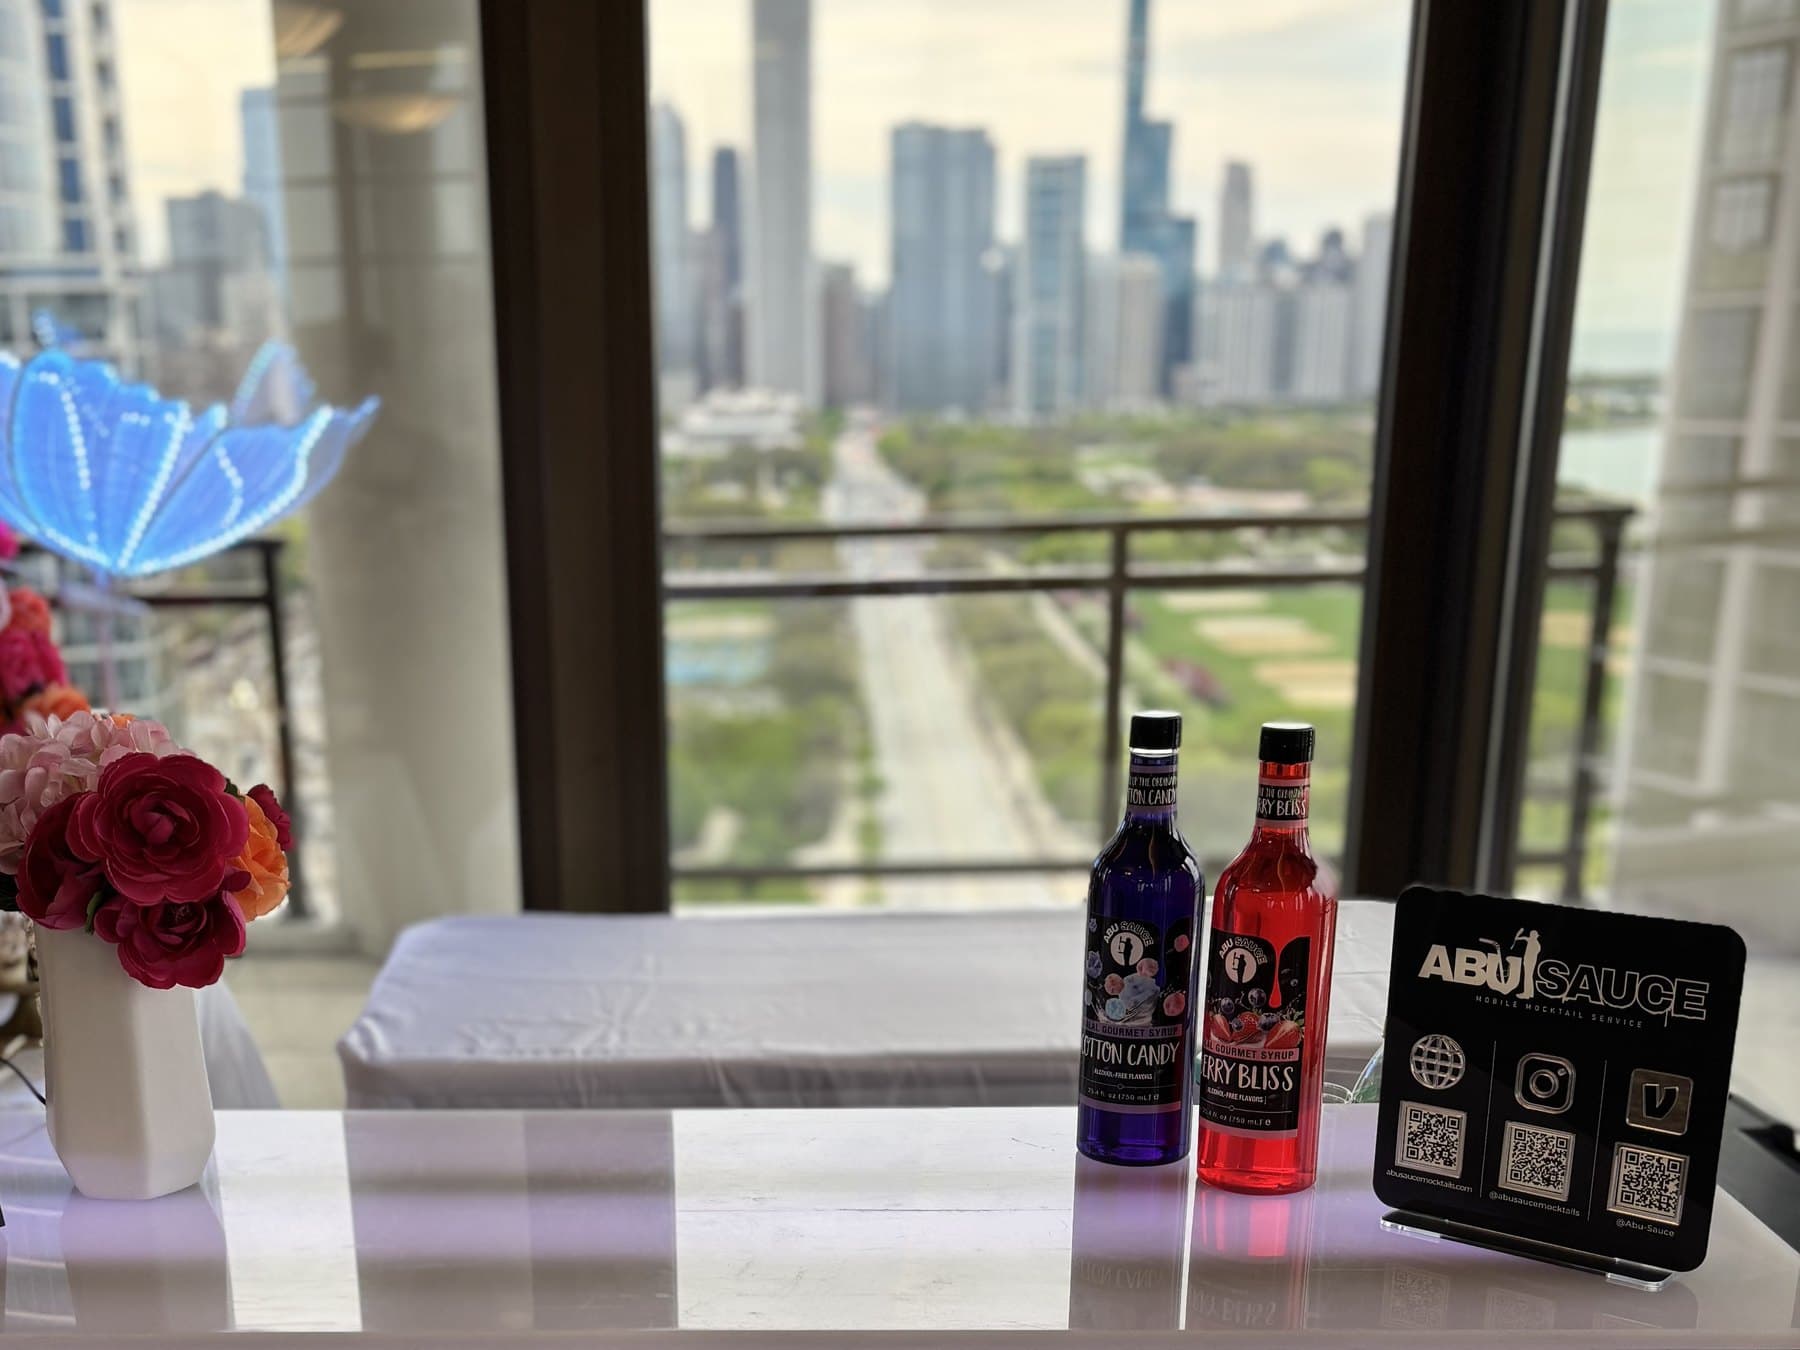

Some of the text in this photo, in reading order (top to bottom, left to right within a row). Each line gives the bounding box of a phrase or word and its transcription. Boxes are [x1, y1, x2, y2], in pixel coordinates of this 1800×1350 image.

[1276, 798, 1306, 816] BLISS
[1103, 920, 1154, 948] ABU SAUCE
[1218, 936, 1268, 965] ABU SAUCE
[1418, 944, 1710, 1022] ABU SAUCE
[1475, 995, 1643, 1028] MOBILE MOCKTAIL SERVICE
[1102, 1026, 1145, 1038] GOURMET
[1127, 1042, 1180, 1067] CANDY
[1215, 1043, 1257, 1059] GOURMET
[1261, 1050, 1294, 1060] SYRUP
[1238, 1063, 1294, 1092] BLISS
[1386, 1169, 1473, 1193] abusaucemocktails.com
[1489, 1190, 1580, 1217] @abusaucemocktails
[1615, 1218, 1675, 1238] @Abu-Sauce
